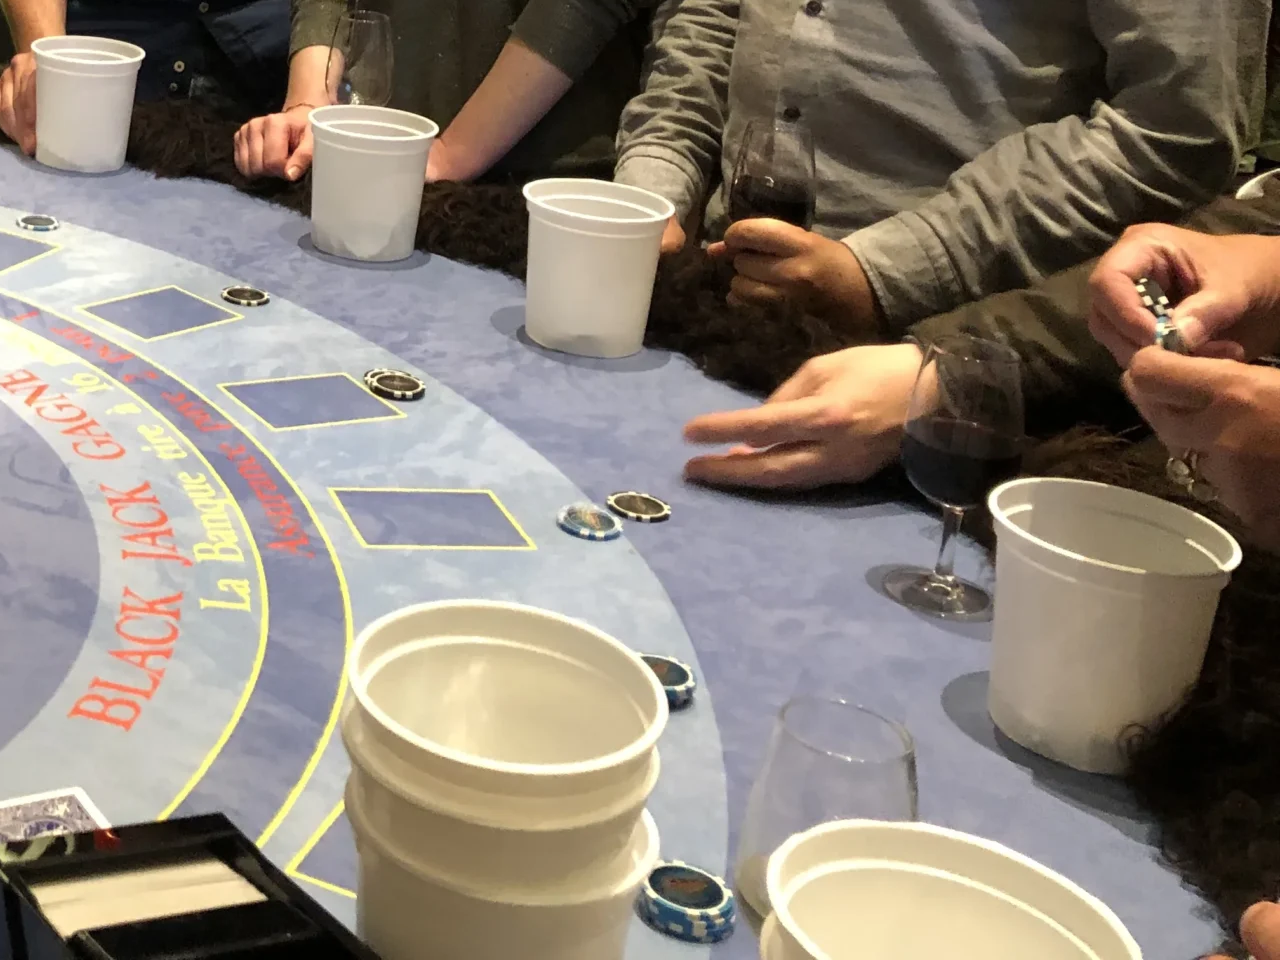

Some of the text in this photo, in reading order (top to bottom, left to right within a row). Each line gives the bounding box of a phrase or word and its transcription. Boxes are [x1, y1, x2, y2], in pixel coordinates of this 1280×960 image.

[99, 480, 193, 568] JACK
[178, 471, 245, 563] Banque
[200, 578, 251, 612] La
[67, 586, 184, 732] BLACK
